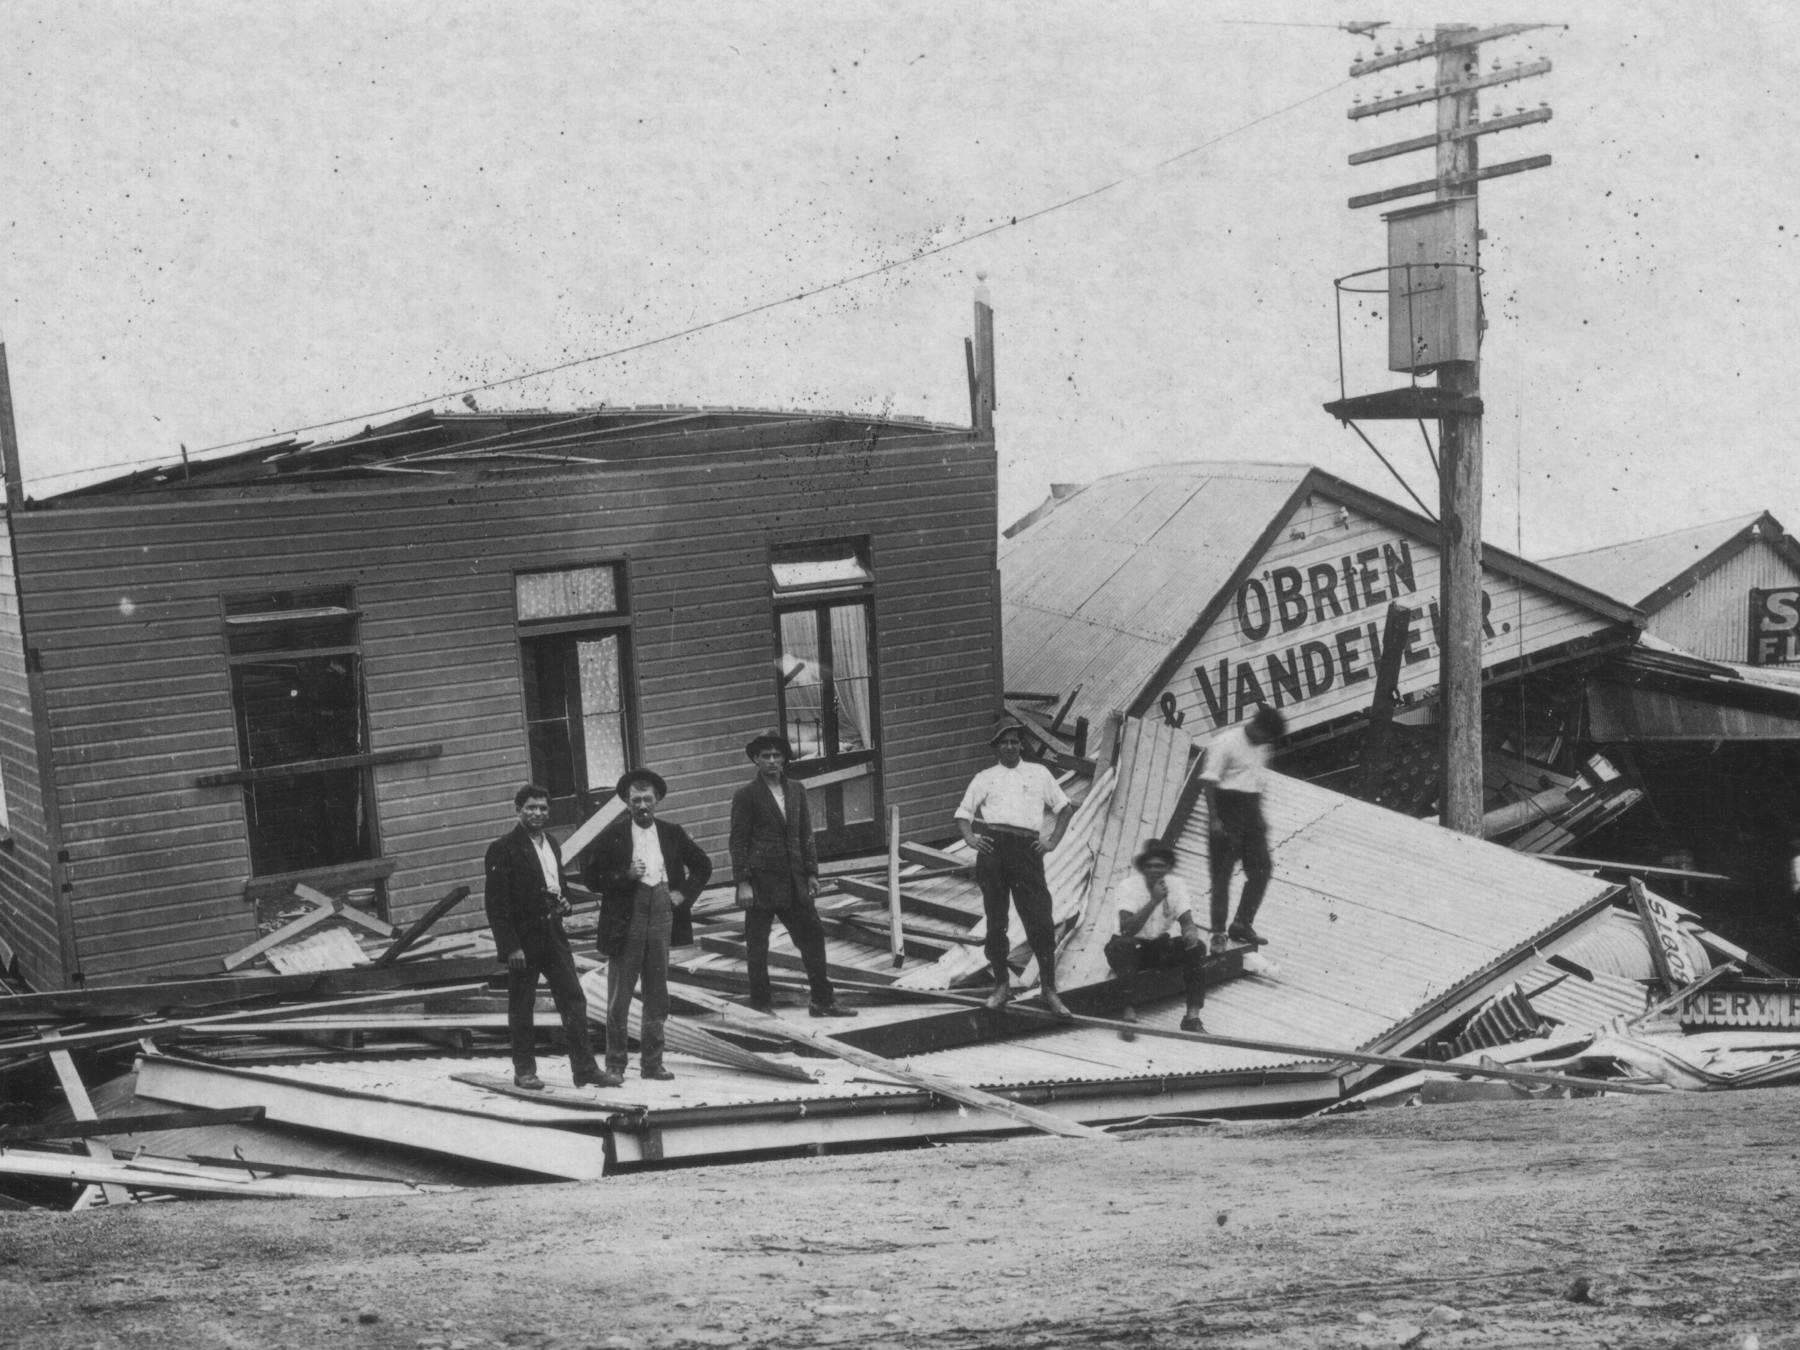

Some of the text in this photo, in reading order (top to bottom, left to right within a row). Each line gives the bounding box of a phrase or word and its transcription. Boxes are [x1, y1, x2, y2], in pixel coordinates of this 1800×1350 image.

[1237, 540, 1416, 641] O'BRIEN
[1160, 692, 1185, 729] &
[1661, 993, 1774, 1017] KERY,
